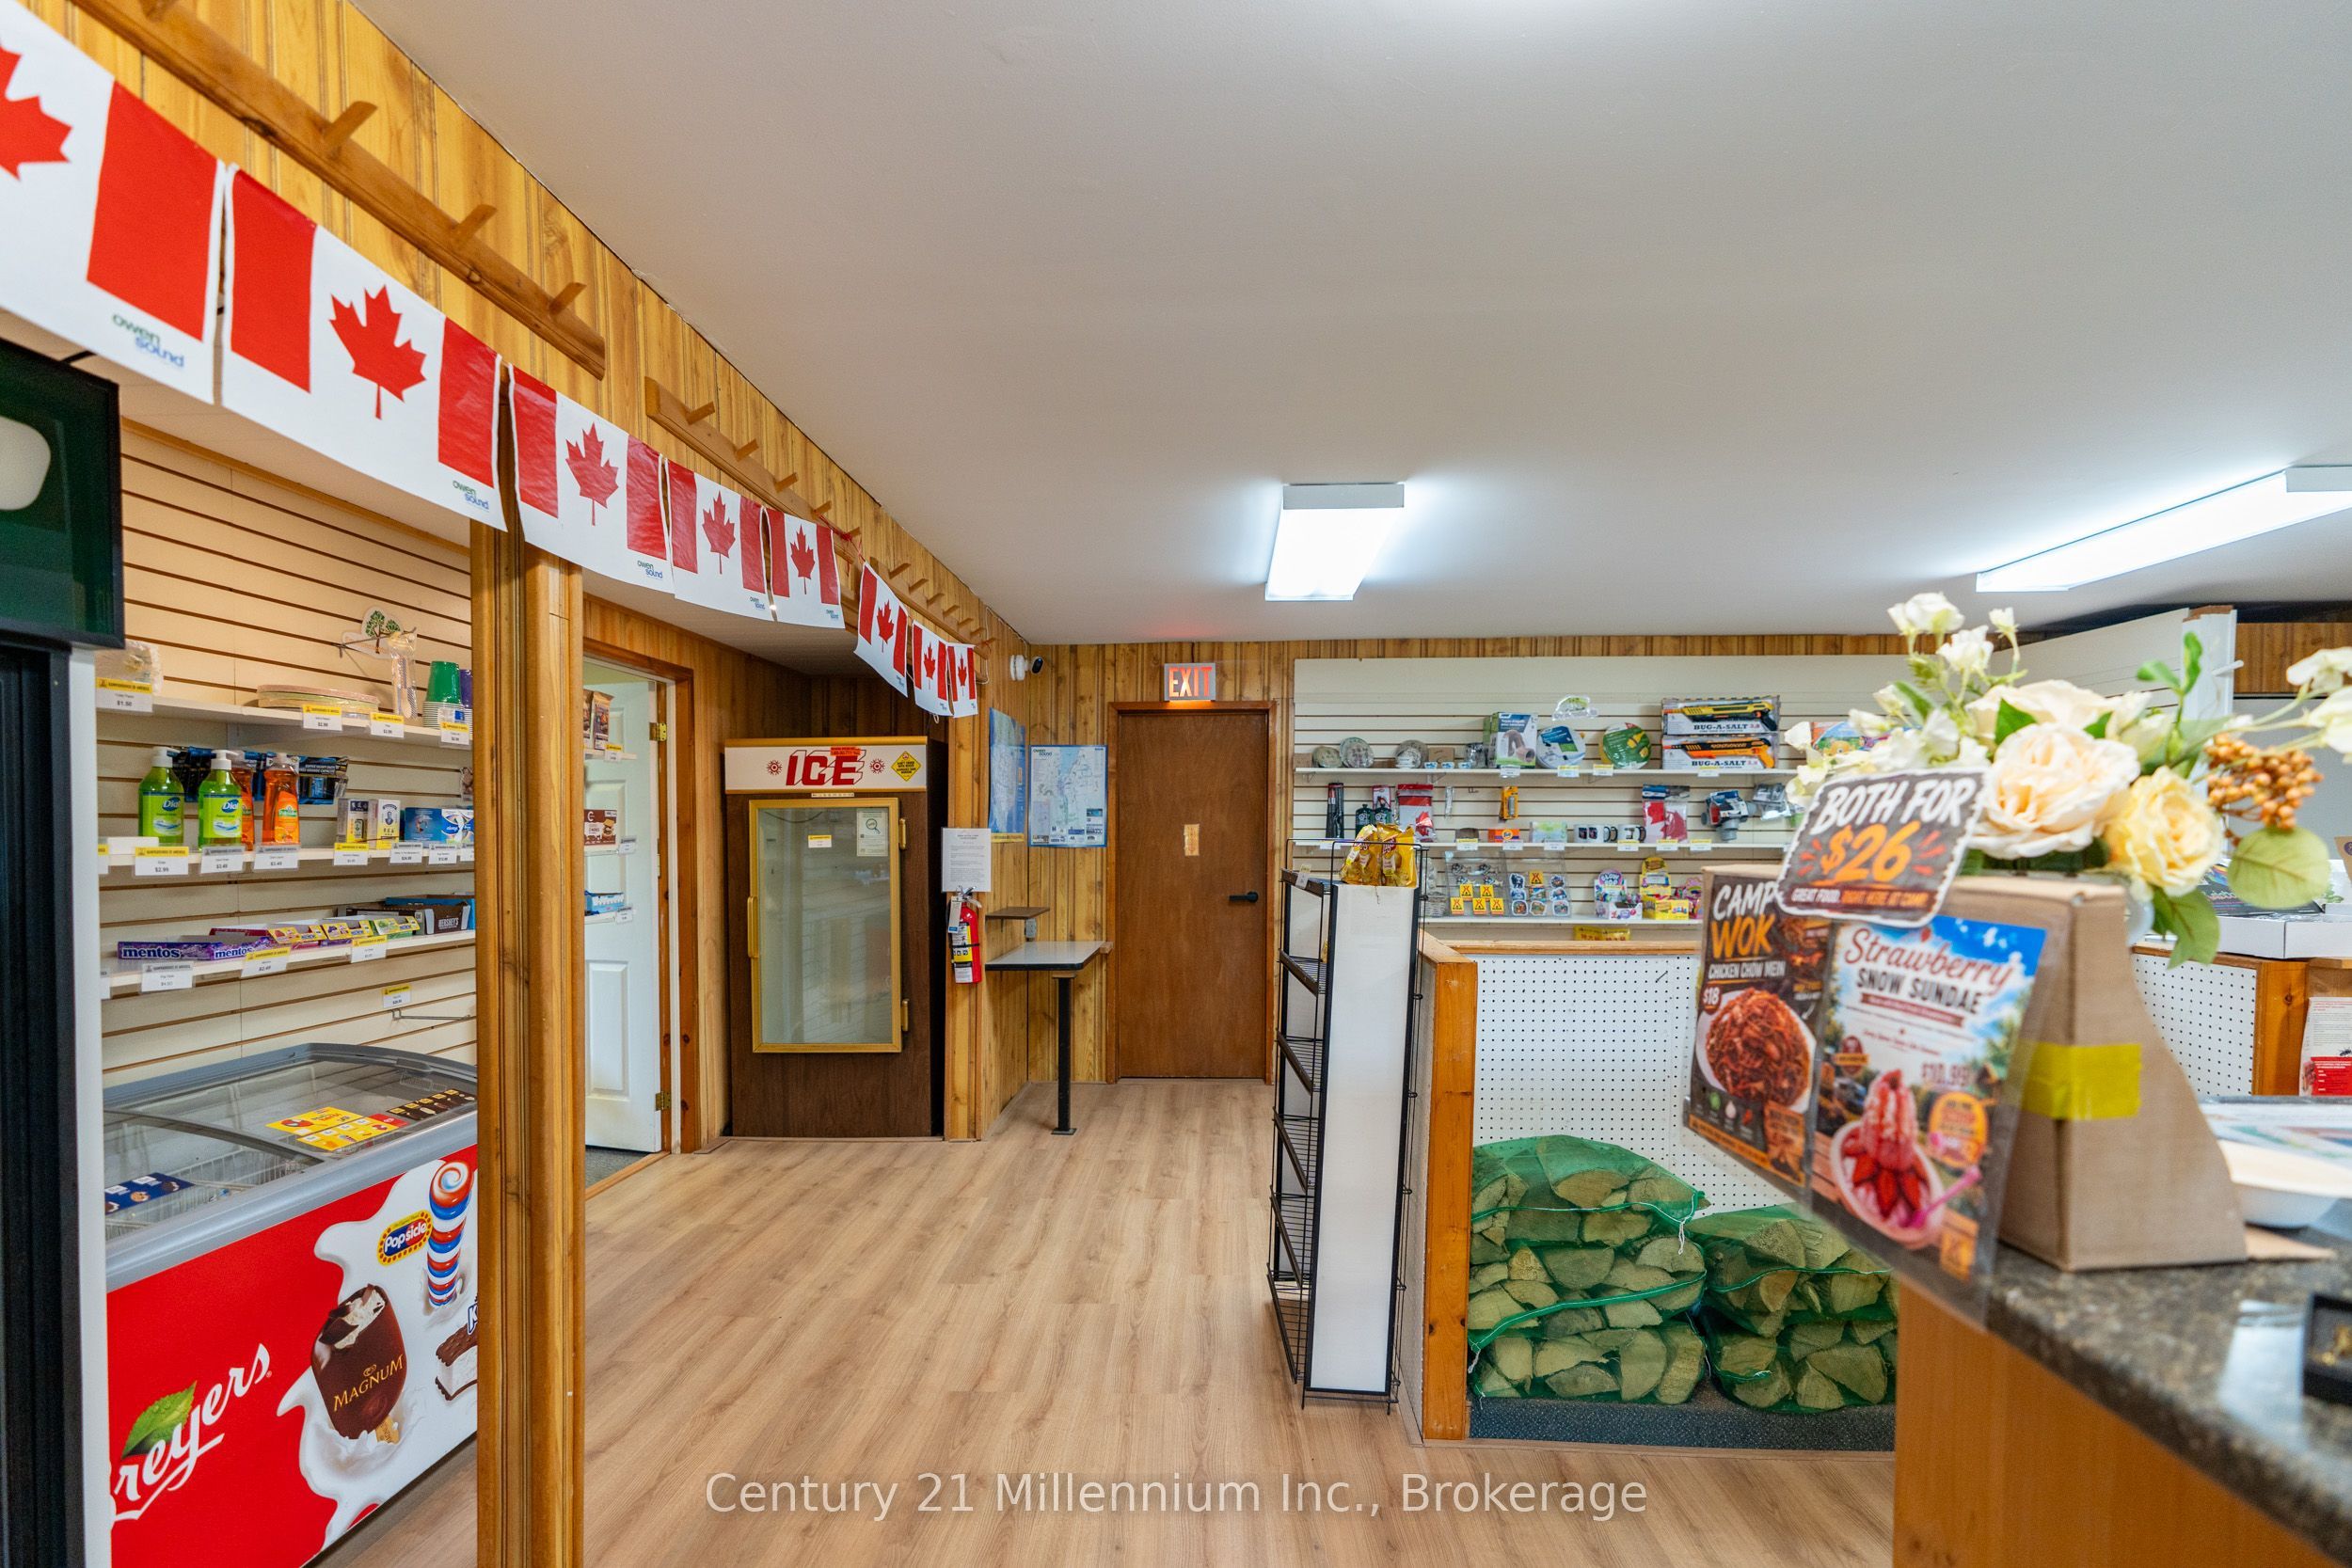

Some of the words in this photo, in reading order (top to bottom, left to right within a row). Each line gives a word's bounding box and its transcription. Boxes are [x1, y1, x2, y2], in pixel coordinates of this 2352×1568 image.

[1168, 666, 1213, 697] EXIT
[786, 750, 866, 785] ICE
[163, 799, 180, 809] Dial
[222, 800, 239, 811] Dial
[1810, 780, 1900, 835] BOTH
[1899, 777, 1976, 827] FOR
[1820, 820, 1921, 882] $26
[1713, 881, 1779, 920] CAMP
[122, 946, 181, 958] mentos
[215, 945, 253, 958] mentos
[1711, 913, 1775, 959] WOK
[1708, 963, 1740, 979] CHICKEN
[1740, 962, 1764, 978] CHOW
[1764, 960, 1787, 977] MEIN
[1844, 927, 2014, 996] Strawberry
[1703, 987, 1721, 1006] $18
[1856, 967, 1906, 994] SNOW
[1909, 977, 1982, 1015] SUNDAE
[384, 1221, 429, 1253] Popsicle
[333, 1354, 405, 1412] MAGNUM
[110, 1343, 271, 1521] reyers
